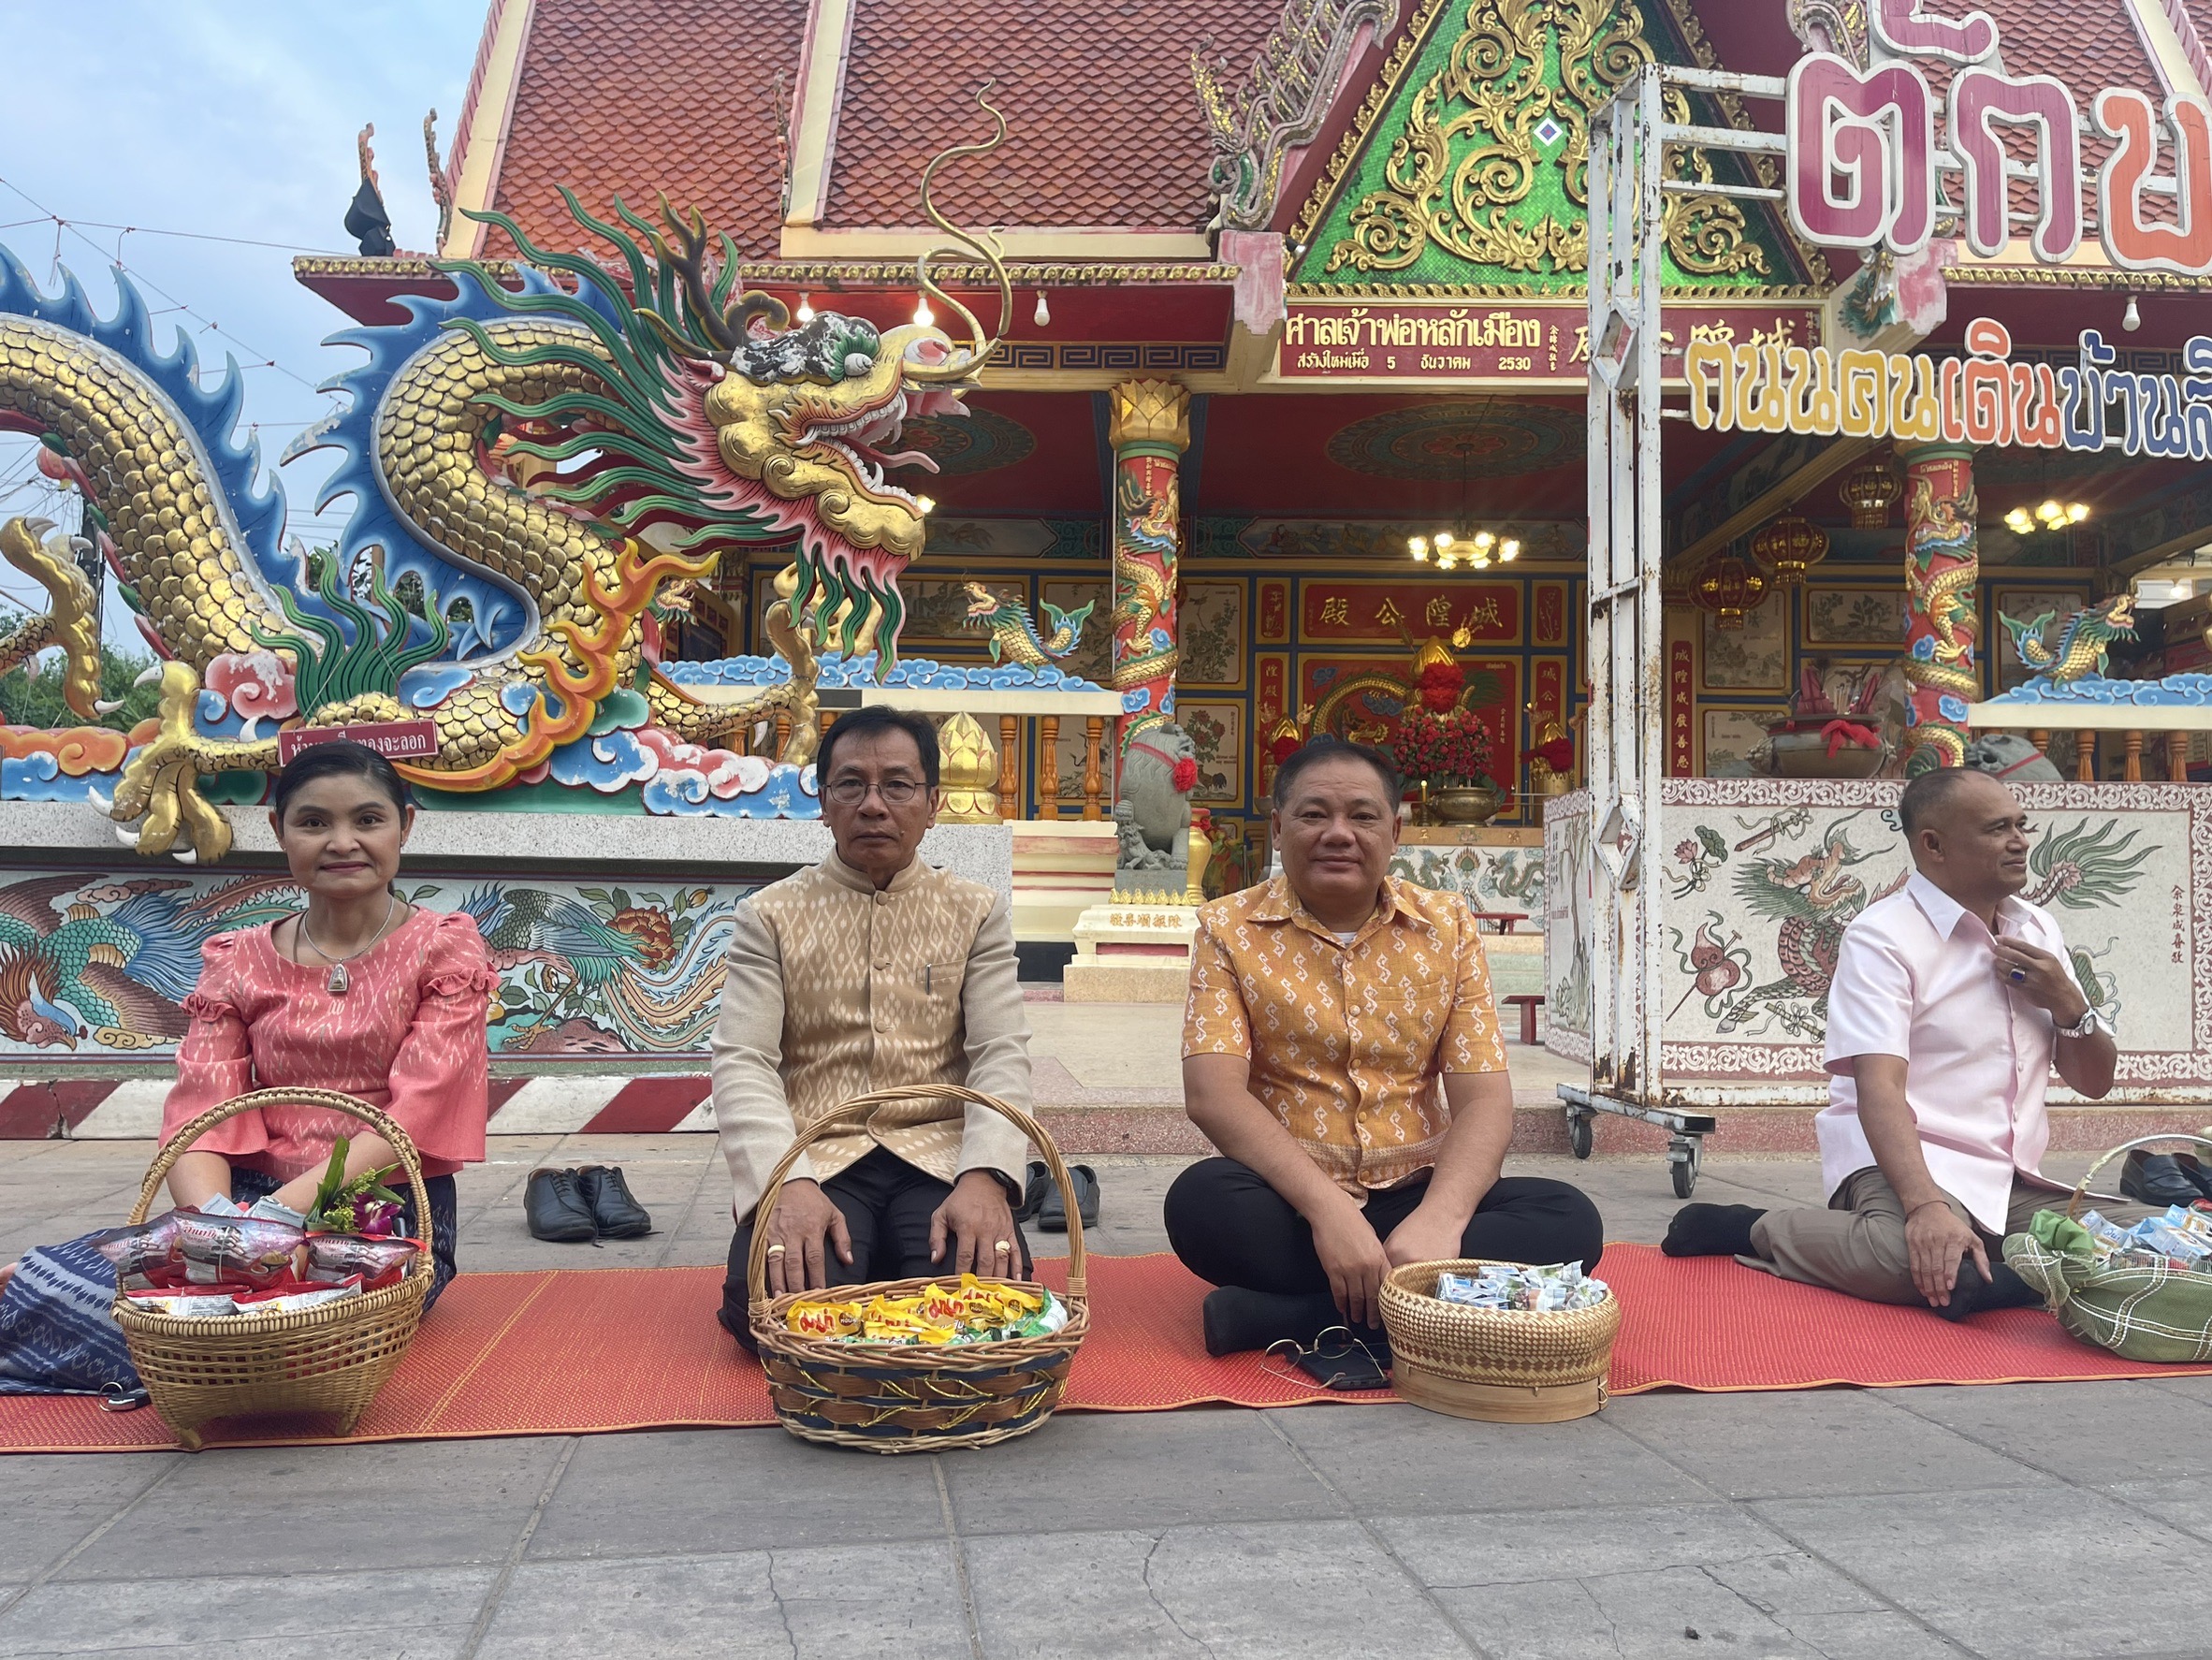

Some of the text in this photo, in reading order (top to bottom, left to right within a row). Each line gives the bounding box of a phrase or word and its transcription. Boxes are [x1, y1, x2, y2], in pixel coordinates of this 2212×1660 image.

[1286, 307, 1540, 347] ศาลเจ้าพ่อหลักเมือง
[1297, 346, 1532, 371] สร้างใหม่เมื่อ 5 ธันวาคม 2530
